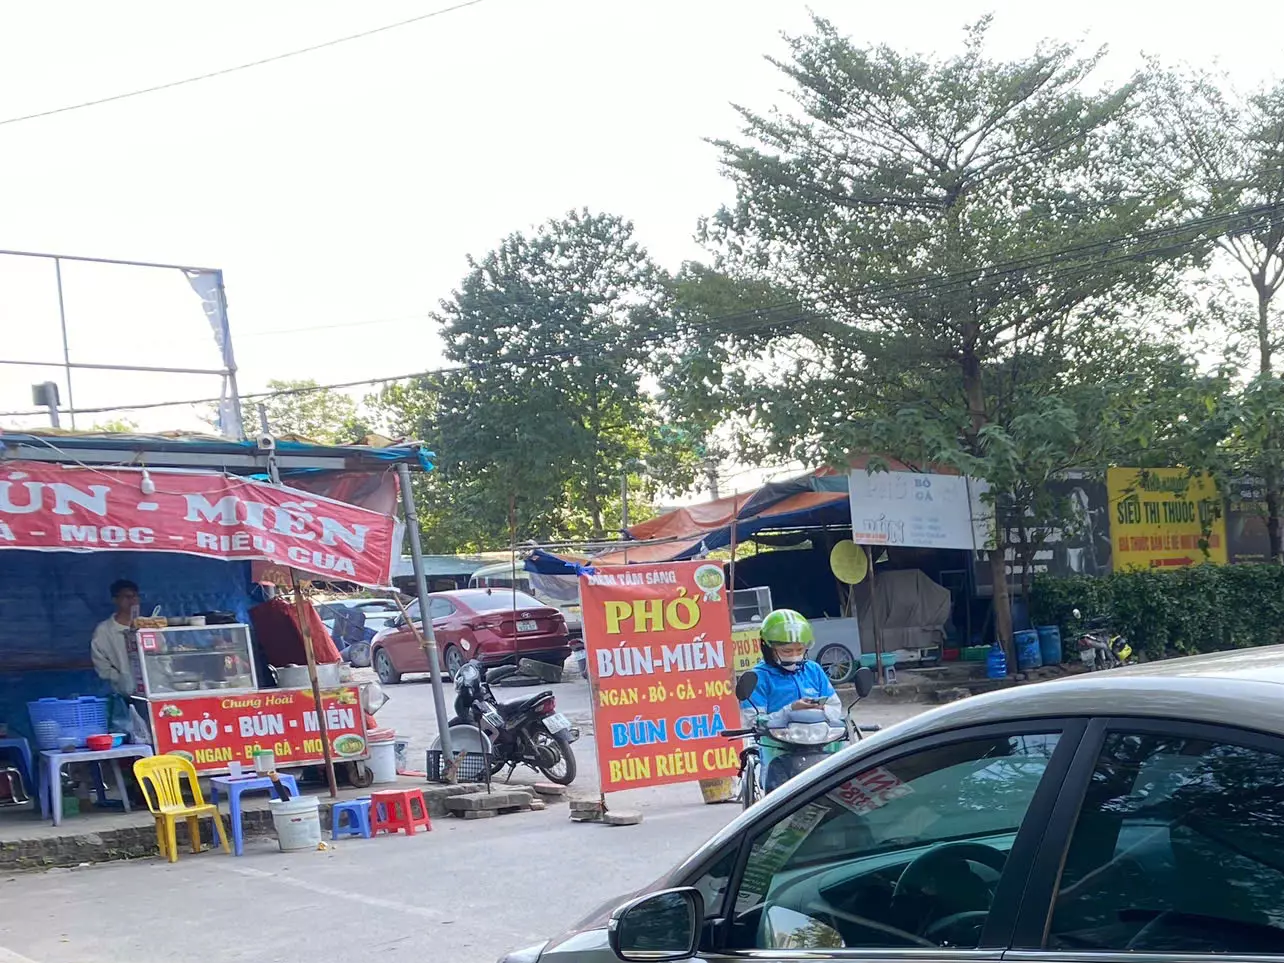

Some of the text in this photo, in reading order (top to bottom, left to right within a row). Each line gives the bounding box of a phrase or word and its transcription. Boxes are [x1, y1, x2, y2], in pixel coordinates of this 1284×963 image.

[60, 524, 154, 547] MỌC
[196, 531, 275, 553] RIÊU
[288, 546, 356, 577] CUA
[617, 570, 643, 585] TÂM
[646, 570, 676, 585] SÁNG
[604, 586, 701, 634] PHỞ
[222, 697, 261, 709] Chung
[599, 679, 733, 707] NGAN BÒ GÀ MỌC
[169, 712, 217, 744] PHỞ
[238, 711, 285, 738] BÚN
[611, 705, 727, 748] BÚN CHẢ
[195, 747, 233, 763] NGAN
[274, 739, 292, 756] GÀ
[609, 746, 740, 783] BÚN RIÊU CUA
